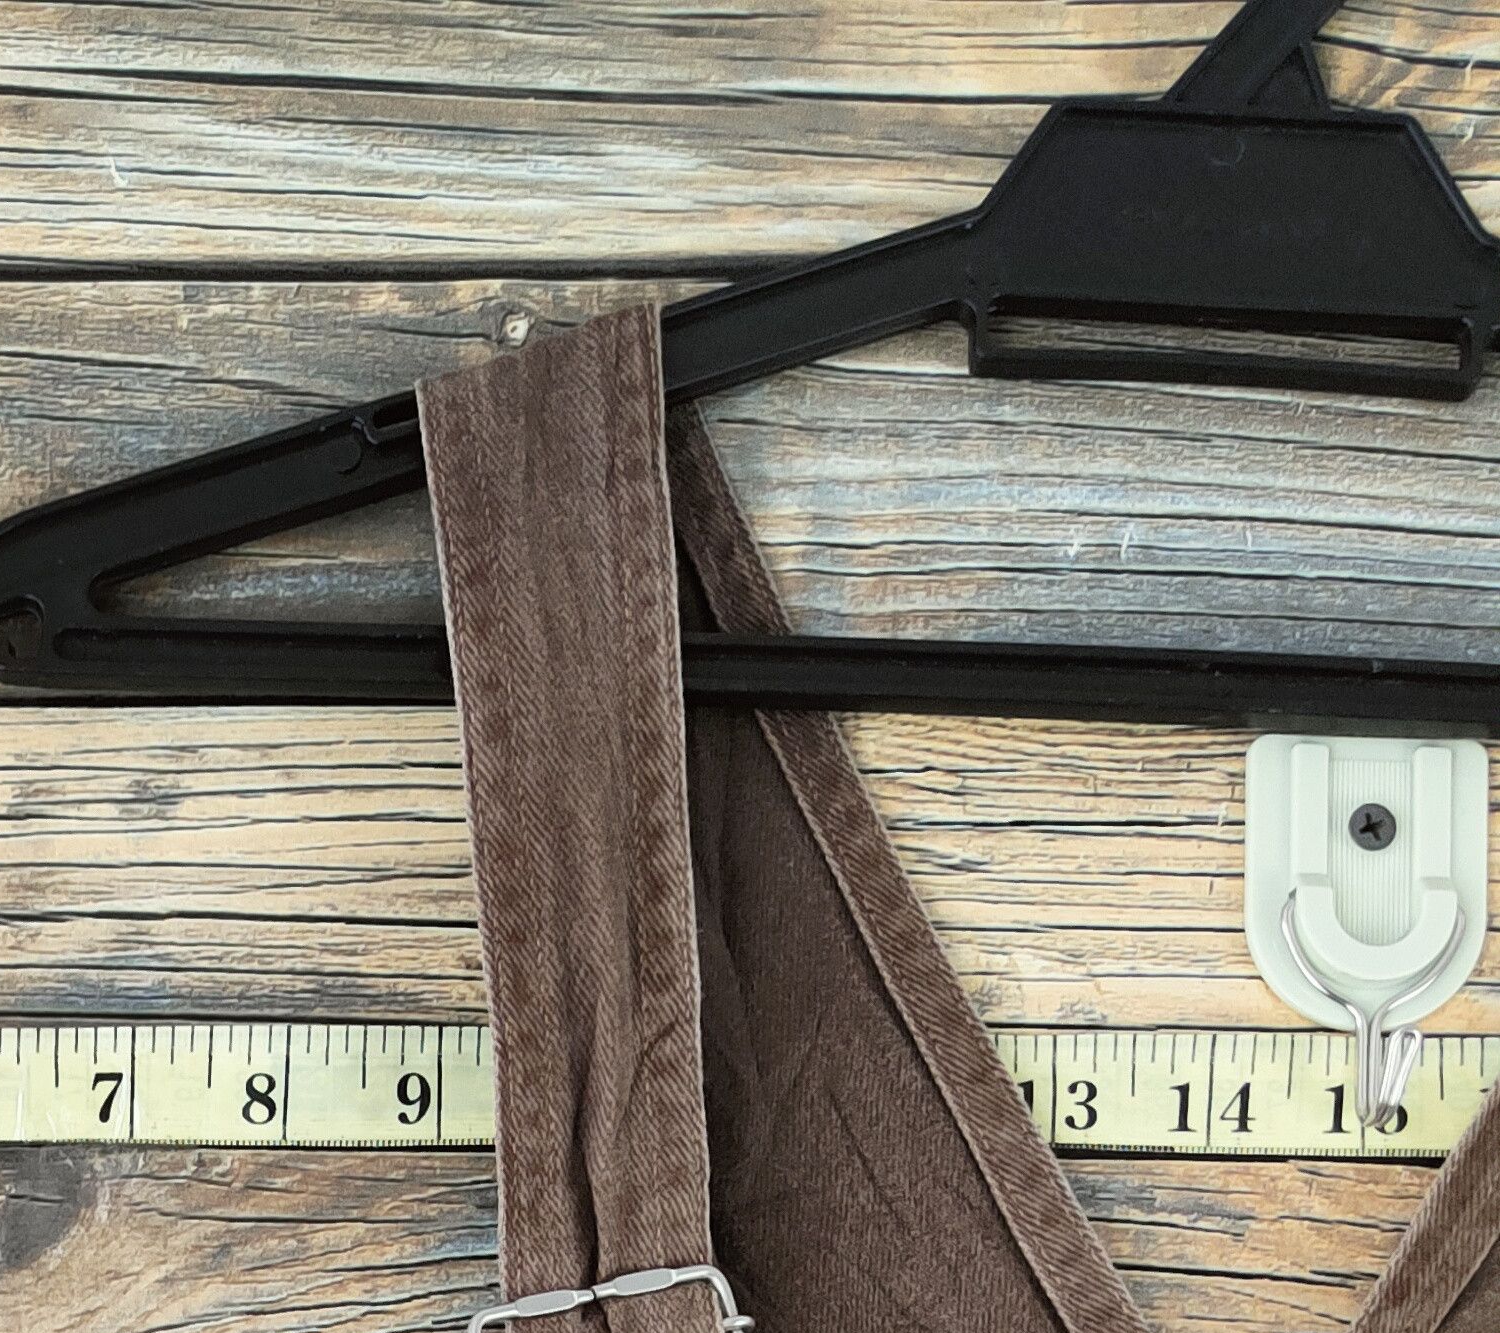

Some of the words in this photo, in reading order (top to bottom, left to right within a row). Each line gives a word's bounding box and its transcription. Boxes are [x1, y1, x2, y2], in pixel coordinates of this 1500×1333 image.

[91, 1073, 124, 1123] 7
[243, 1073, 278, 1125] 8
[397, 1073, 431, 1124] 9
[1169, 1083, 1256, 1134] 14
